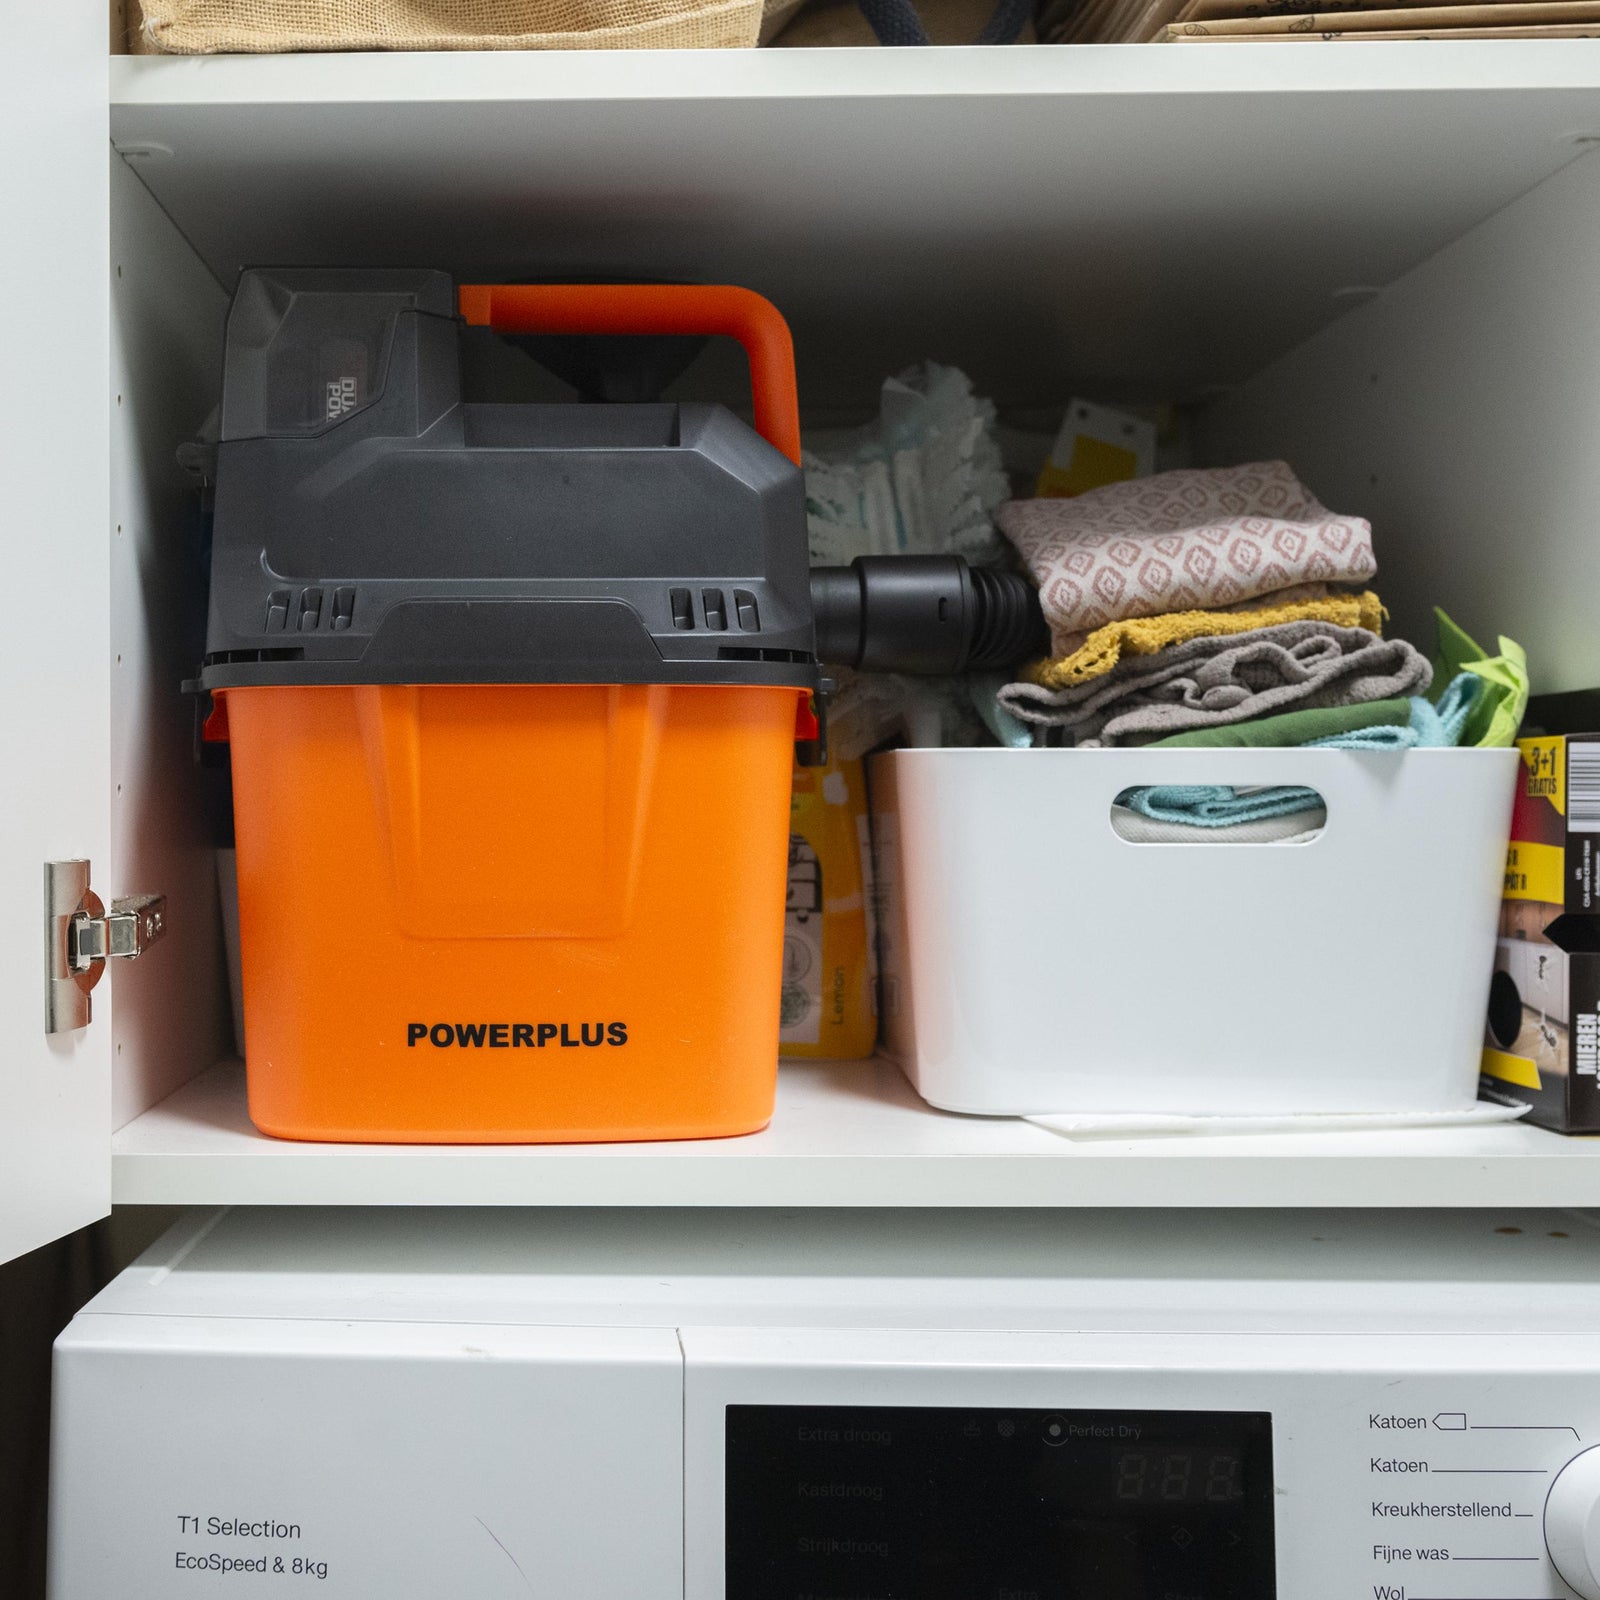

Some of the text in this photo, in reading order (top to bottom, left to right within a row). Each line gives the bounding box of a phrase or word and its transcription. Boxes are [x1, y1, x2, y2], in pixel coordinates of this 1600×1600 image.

[1531, 747, 1557, 776] 3+1
[1528, 778, 1557, 794] GRATIS
[832, 967, 844, 1025] Lemon
[407, 1022, 628, 1048] POWERPLUS
[1577, 1014, 1597, 1075] MIEREN
[1369, 1413, 1427, 1429] Katoen
[797, 1427, 892, 1446] Extra droog
[1068, 1424, 1142, 1440] Perfect Dry
[1370, 1457, 1429, 1473] Katoen
[797, 1482, 884, 1501] Kastdroog
[1372, 1501, 1512, 1517] Kreukherstellend
[177, 1515, 301, 1539] T1 Selection
[797, 1537, 890, 1557] Strijkdroog
[1373, 1545, 1450, 1564] Fijne was
[175, 1552, 328, 1579] EcoSpeed & 8kg
[1373, 1585, 1405, 1600] Wol
